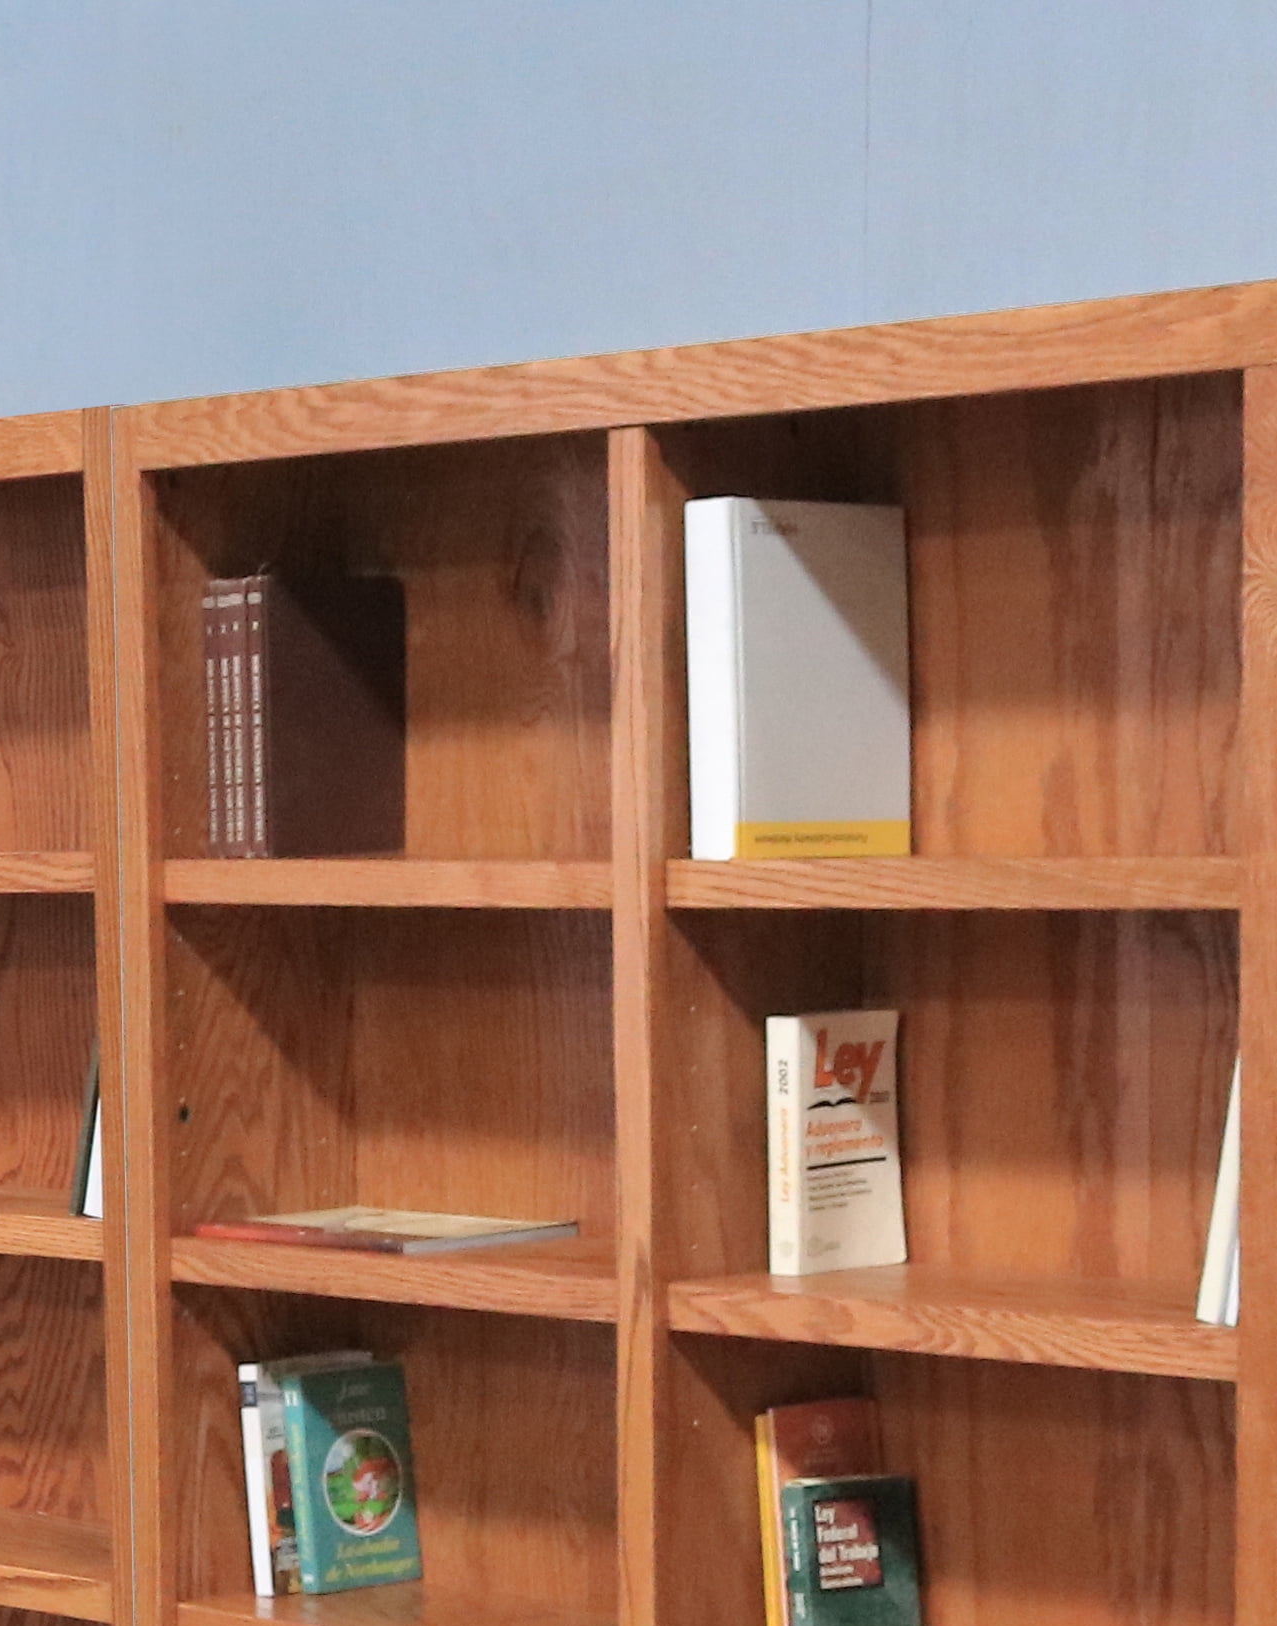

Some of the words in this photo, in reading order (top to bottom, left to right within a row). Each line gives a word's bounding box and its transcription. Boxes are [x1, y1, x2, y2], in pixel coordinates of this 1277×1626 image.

[778, 1060, 789, 1096] 2002
[815, 1028, 887, 1103] Ley
[814, 1504, 836, 1524] Ley
[818, 1546, 838, 1564] del
[838, 1543, 881, 1563] Trabajo
